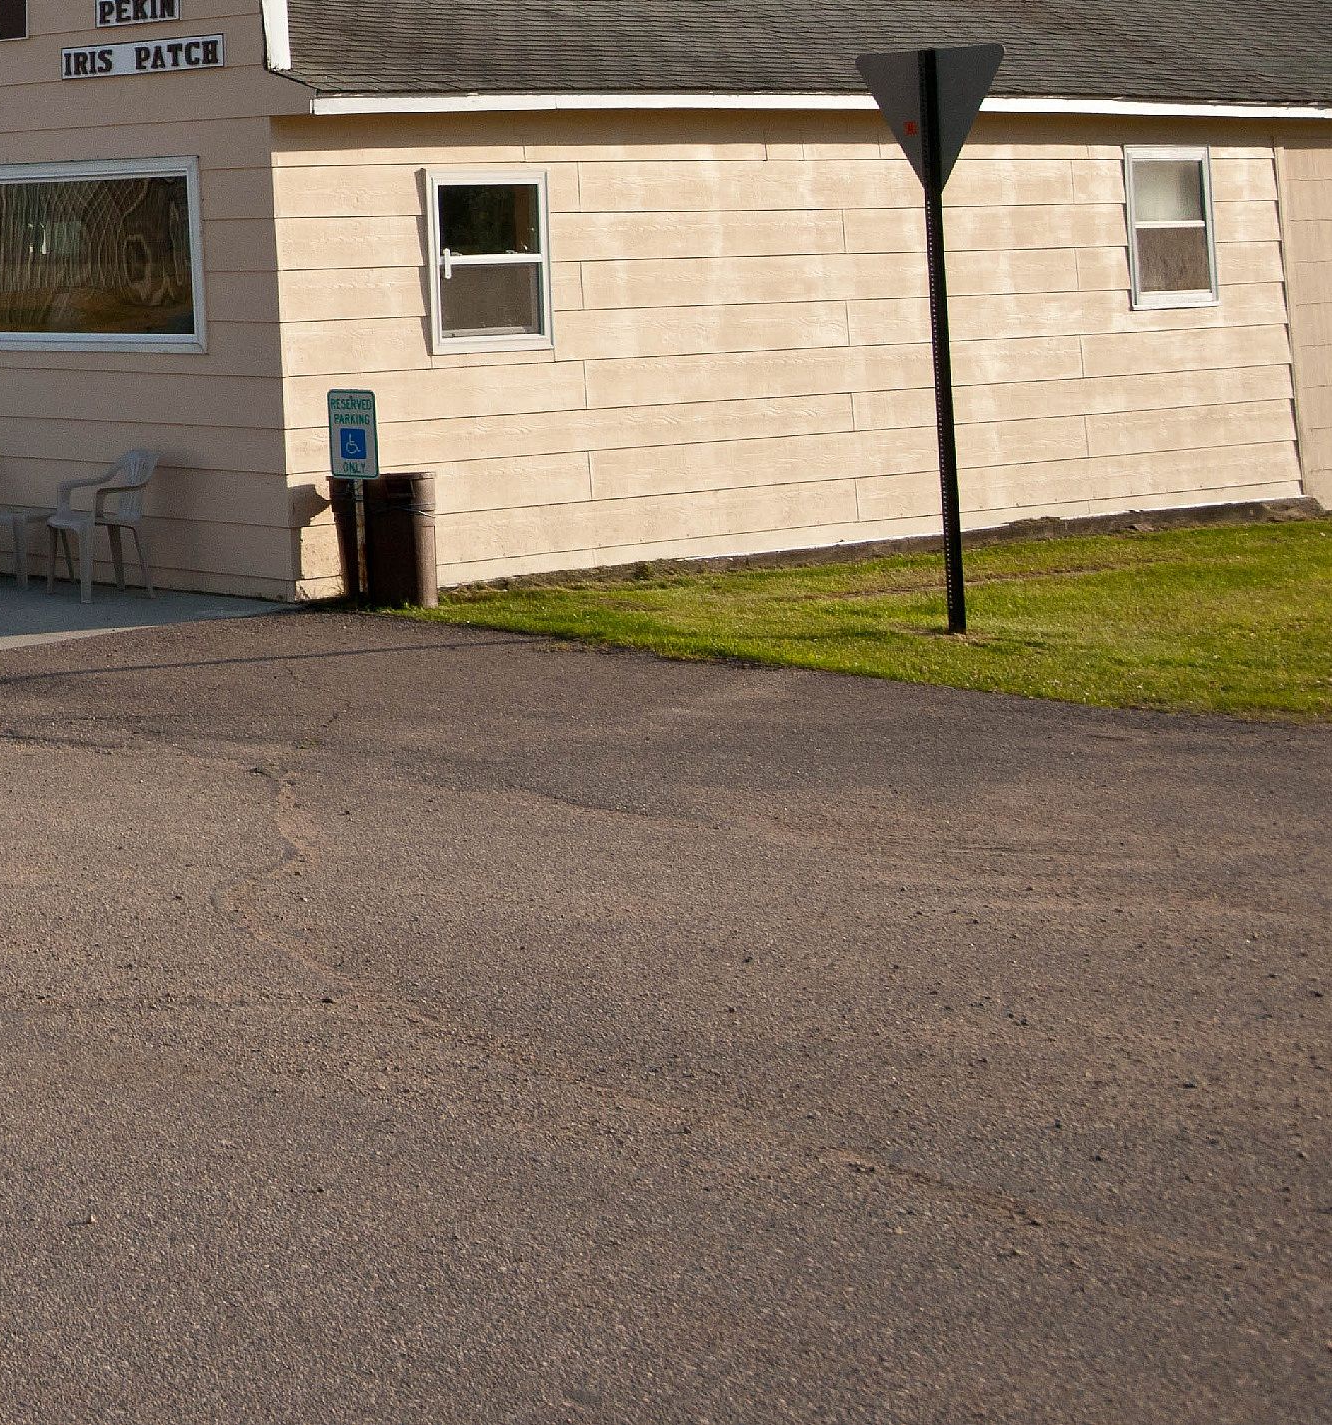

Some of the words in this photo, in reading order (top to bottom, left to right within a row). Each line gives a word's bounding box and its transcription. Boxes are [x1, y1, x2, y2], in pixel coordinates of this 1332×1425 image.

[63, 49, 113, 77] IRIS
[135, 39, 219, 70] PATCH
[330, 398, 373, 411] RESERVED
[333, 414, 371, 425] PARKING
[343, 462, 366, 473] ONLY
